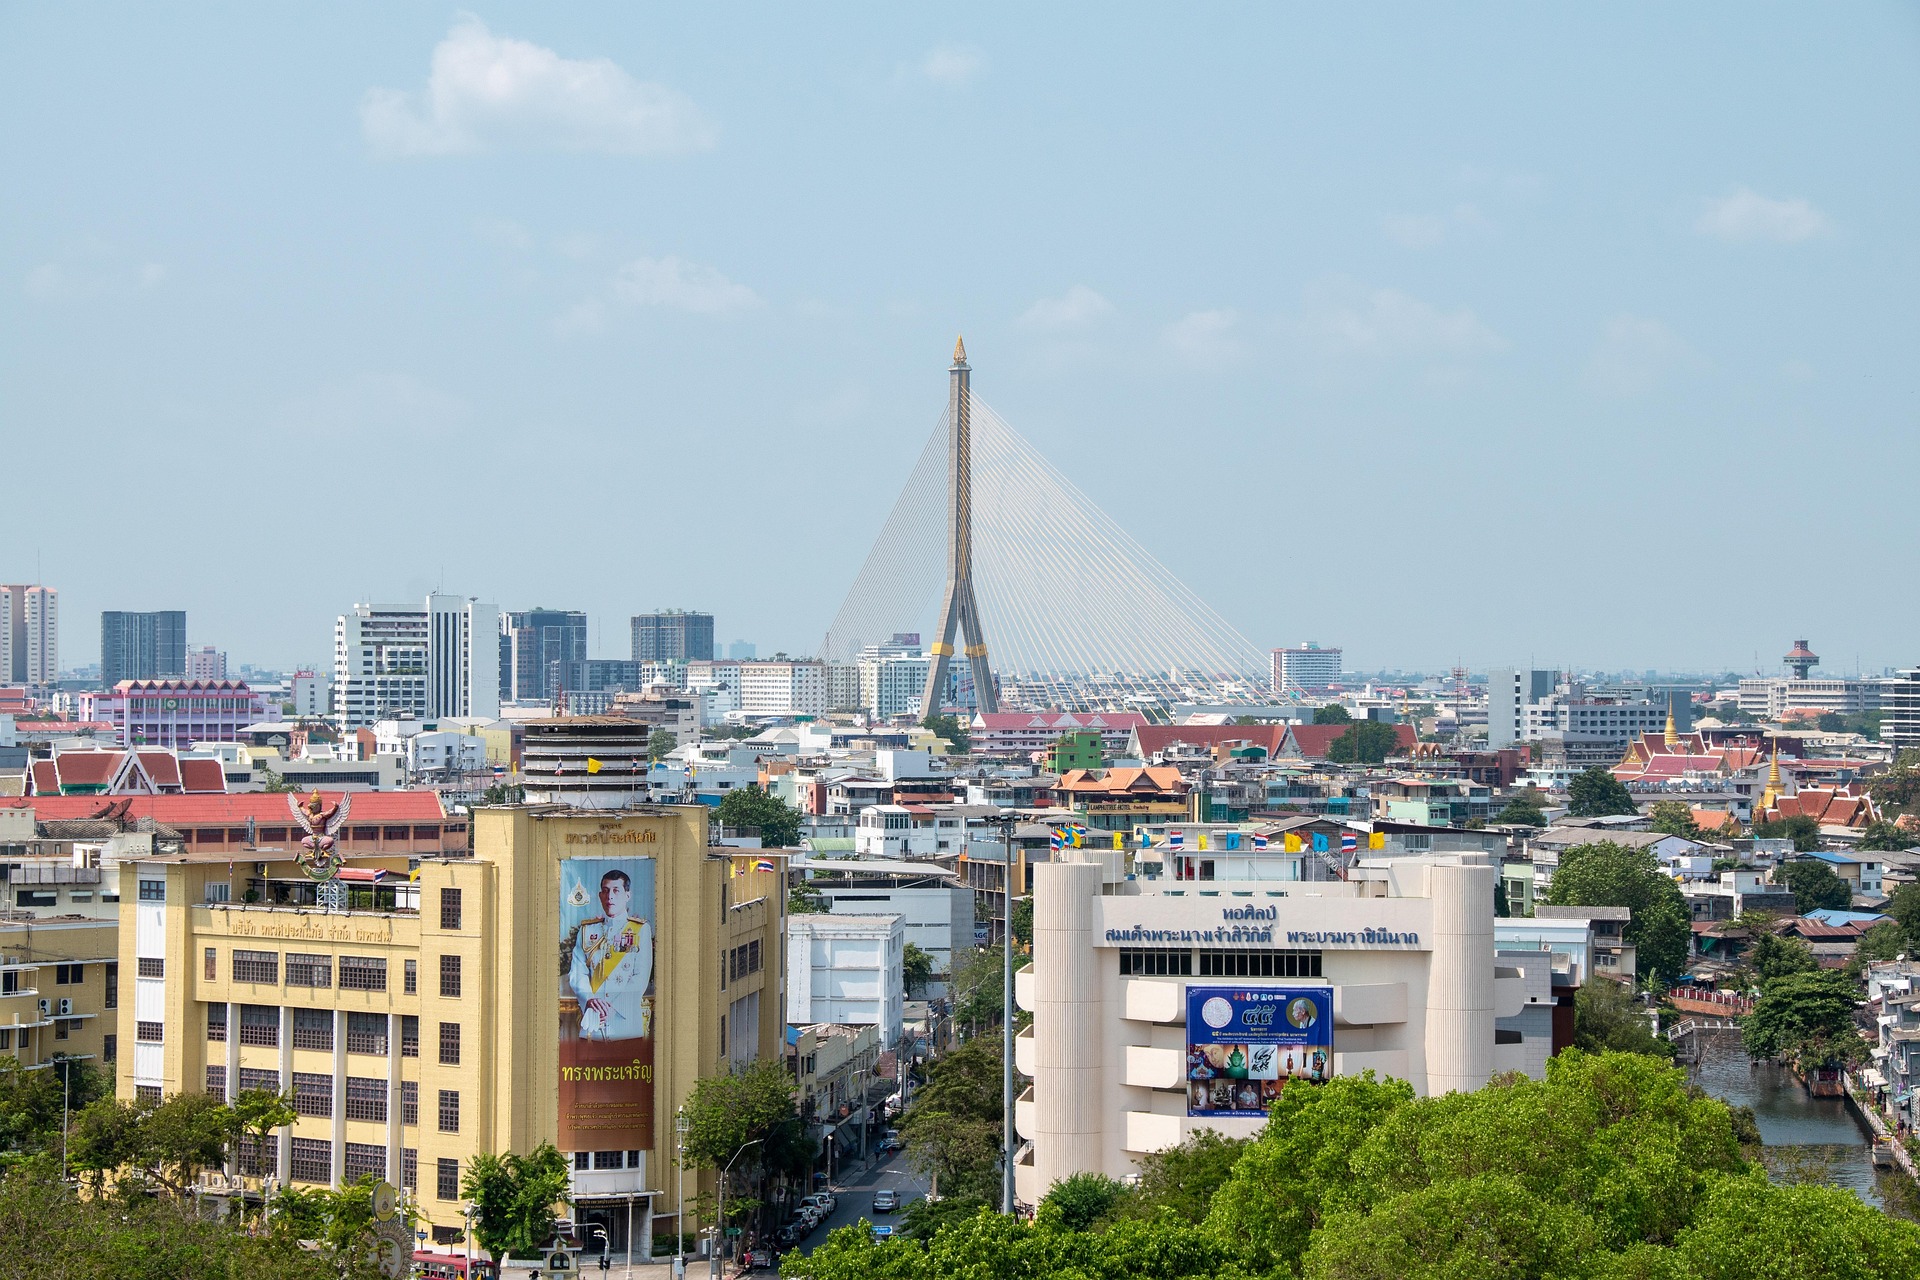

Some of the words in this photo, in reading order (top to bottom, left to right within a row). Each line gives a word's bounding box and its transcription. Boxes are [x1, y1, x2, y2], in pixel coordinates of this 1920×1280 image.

[1222, 904, 1277, 920] หอศิลป์
[1105, 924, 1273, 943] สมเด็จพระนางเจ้าสิริกิติ์
[1287, 927, 1418, 945] พระบรมราชินีนาถ
[562, 1059, 652, 1083] ทรงพระเจริญ
